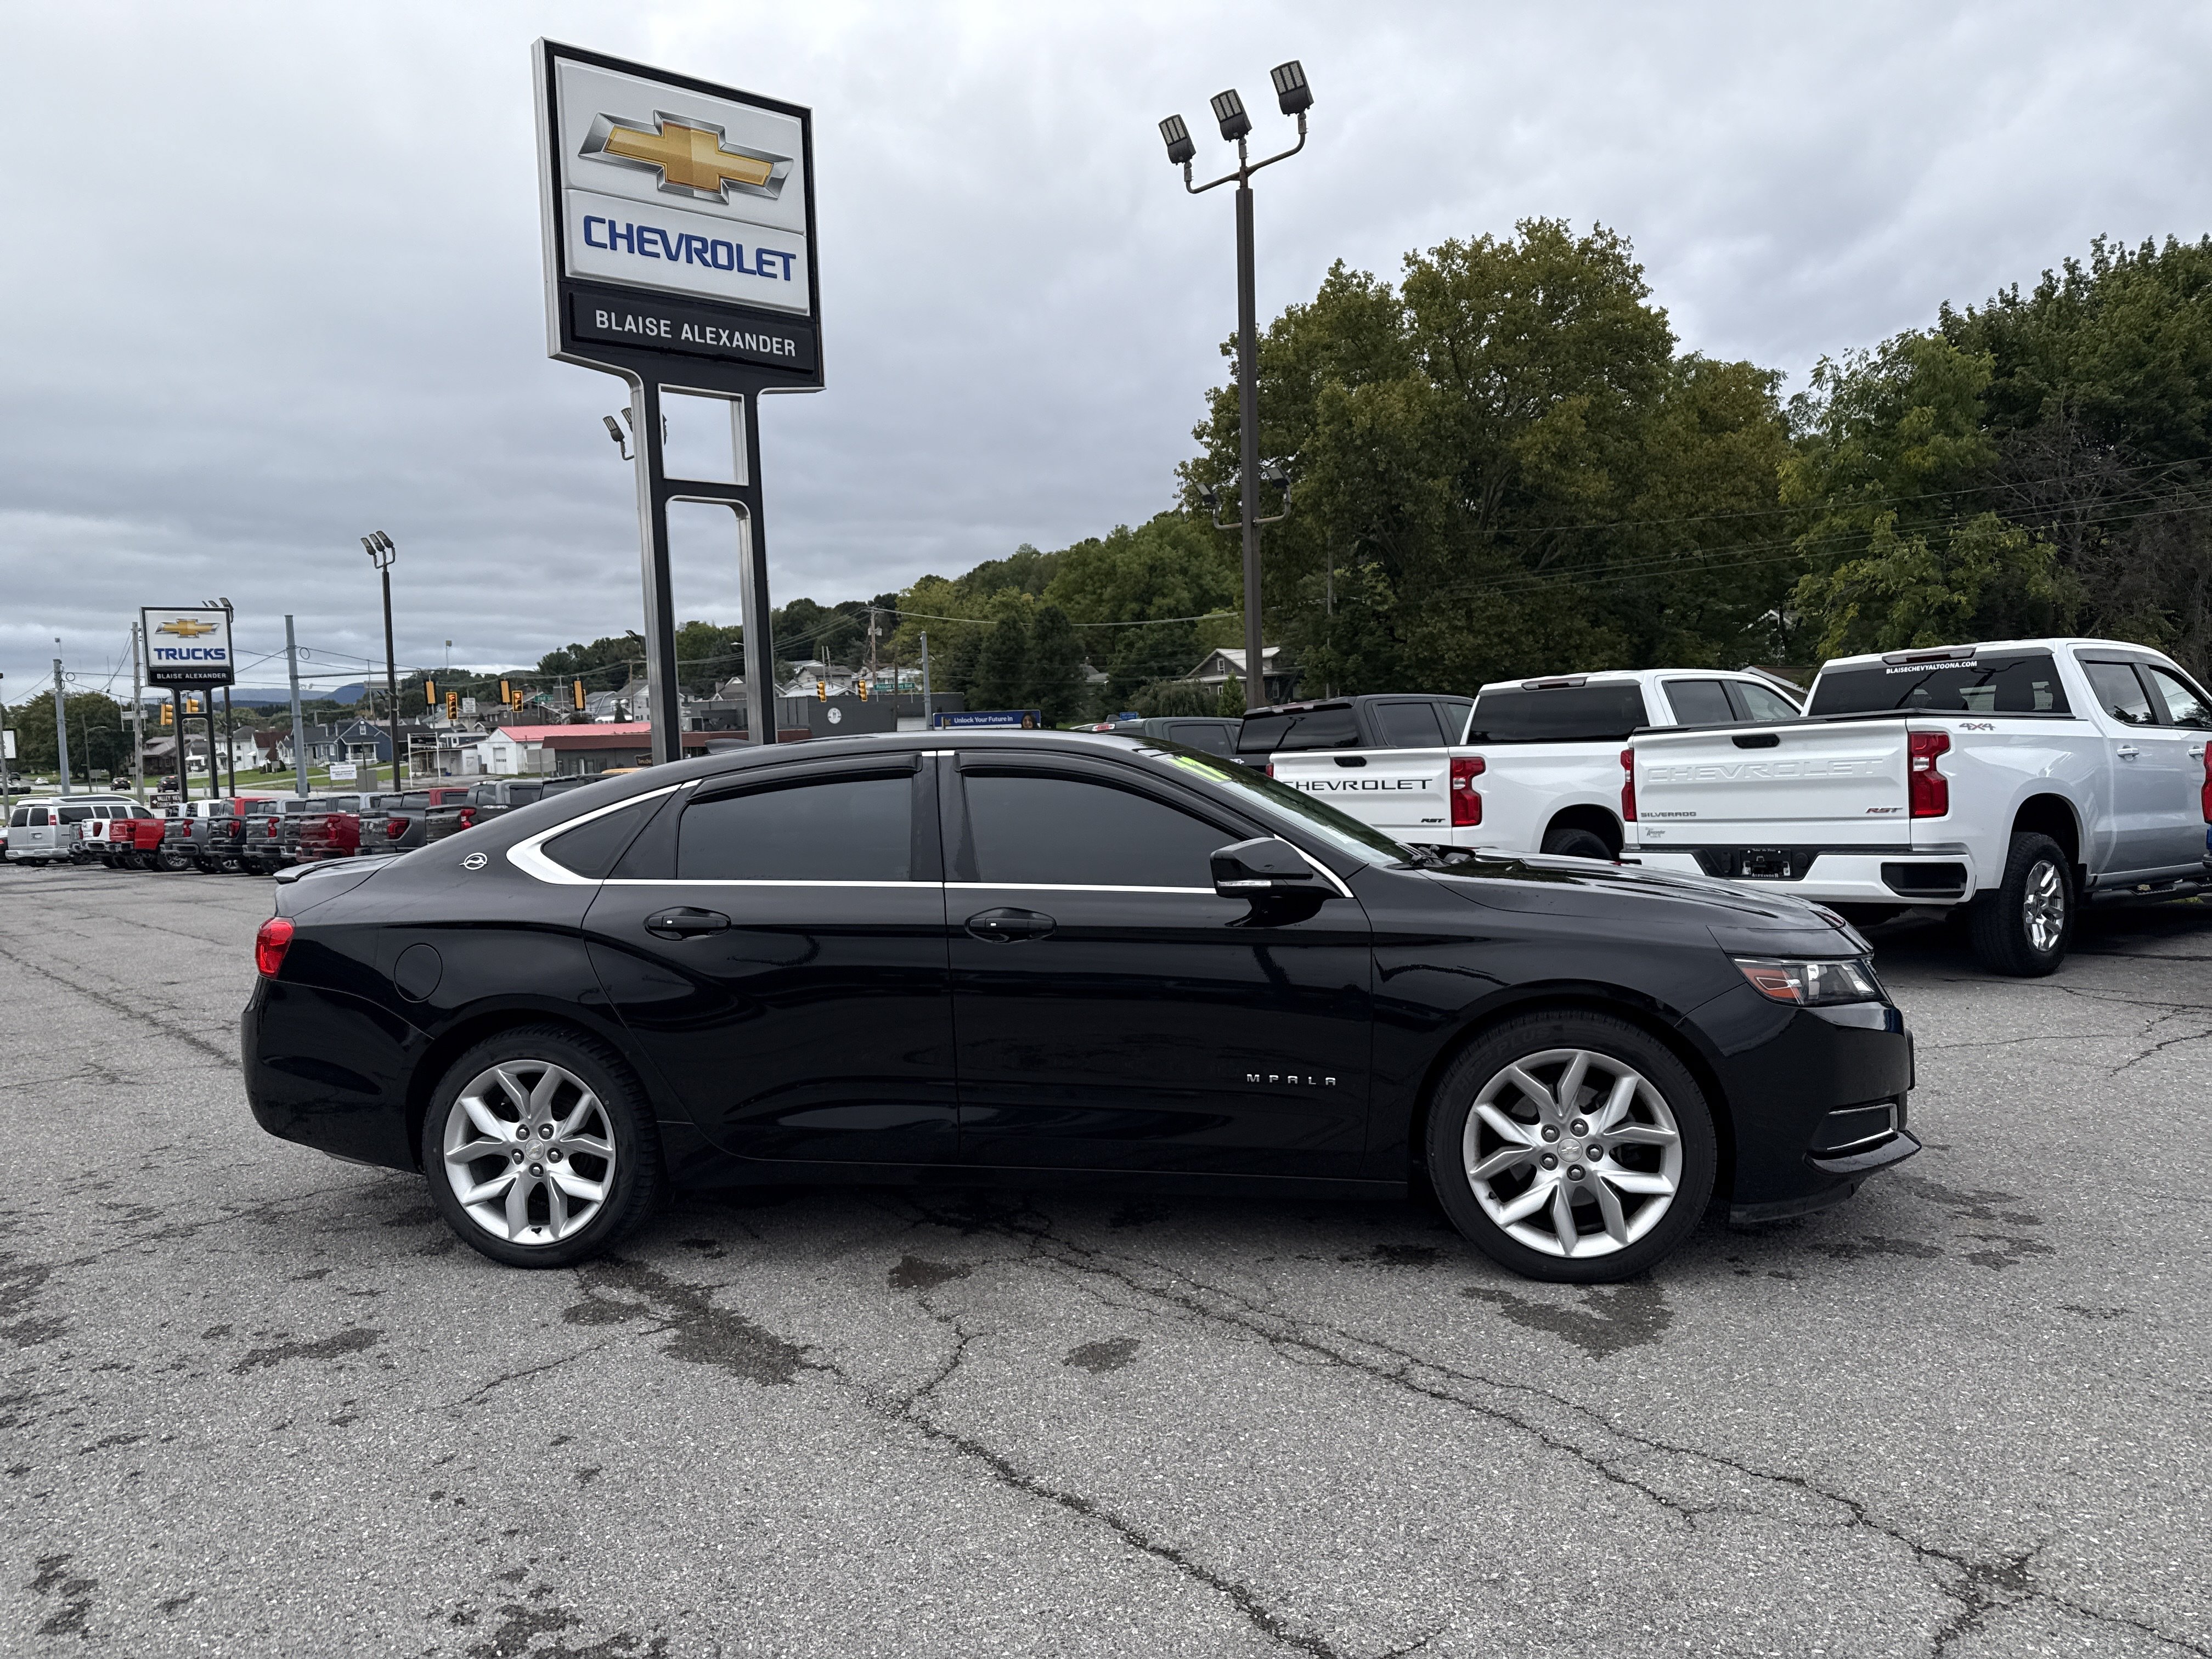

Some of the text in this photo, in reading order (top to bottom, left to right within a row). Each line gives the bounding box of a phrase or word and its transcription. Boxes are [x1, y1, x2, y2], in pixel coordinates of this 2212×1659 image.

[583, 216, 796, 281] CHEVROLET
[595, 309, 796, 357] BLAISE ALEXANDER
[154, 648, 226, 660] TRUCKS
[1886, 661, 1977, 674] BLAISECHEVYALTOONA.COM
[1648, 759, 1883, 782] CHEVROLET
[1246, 1074, 1336, 1086] MPALA
